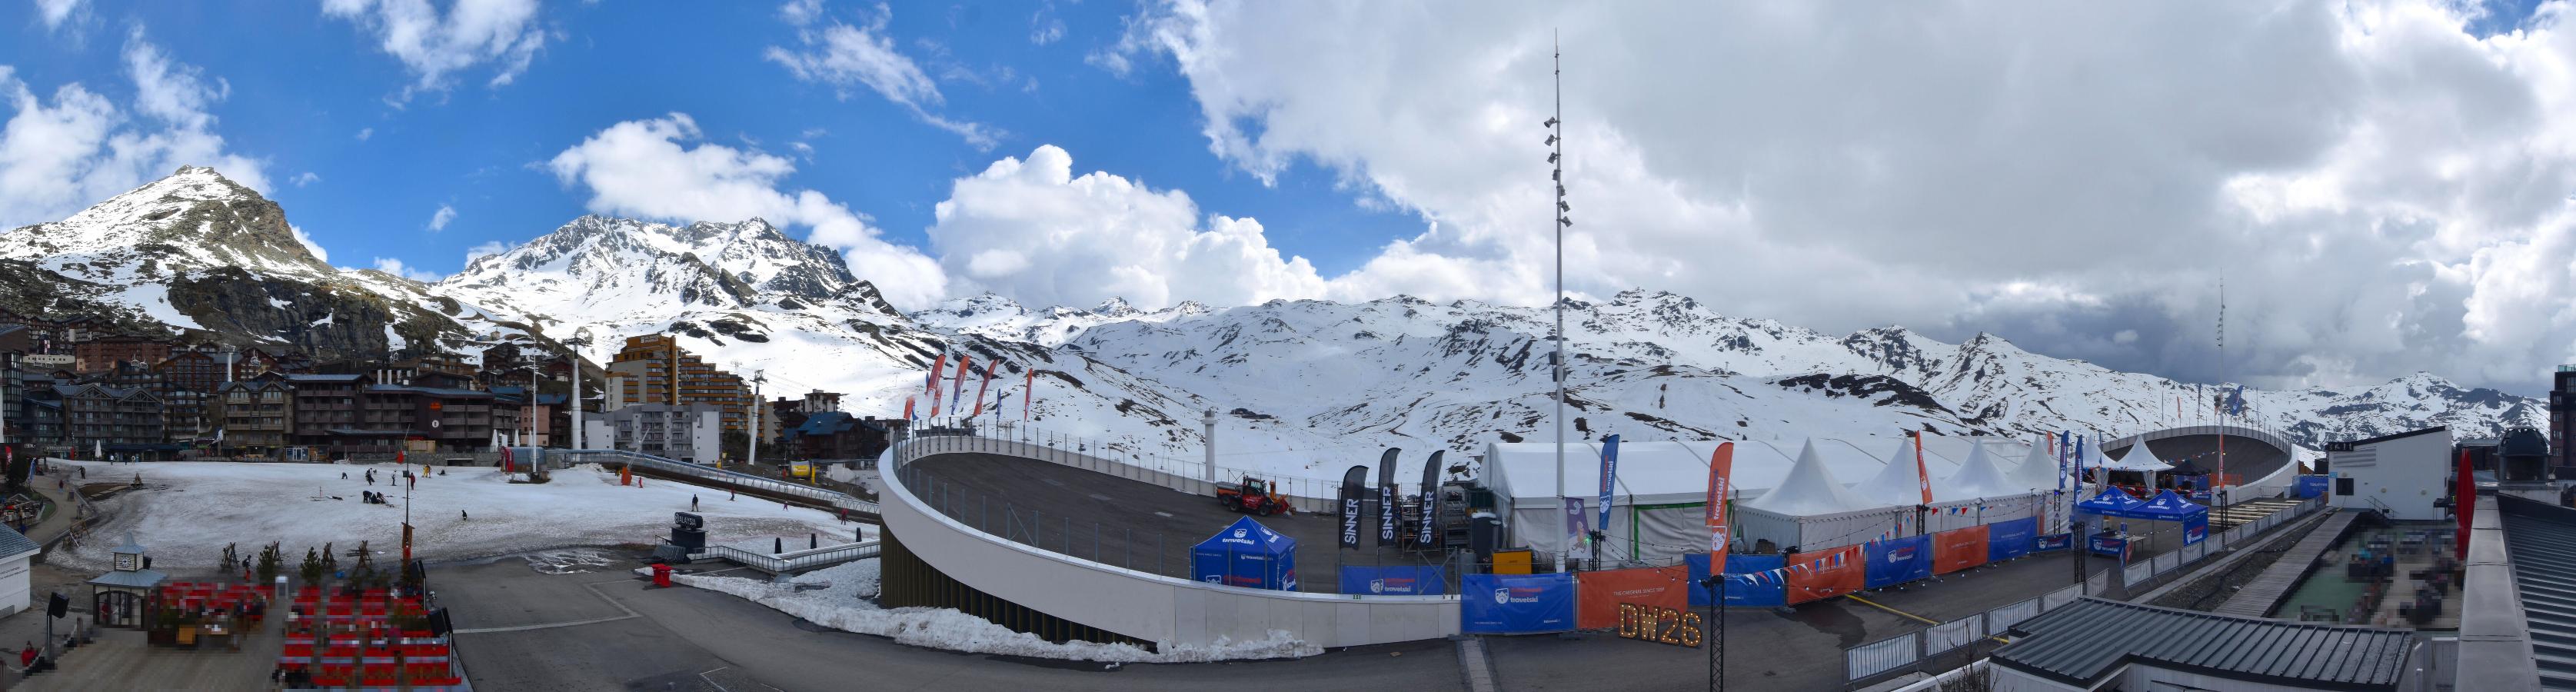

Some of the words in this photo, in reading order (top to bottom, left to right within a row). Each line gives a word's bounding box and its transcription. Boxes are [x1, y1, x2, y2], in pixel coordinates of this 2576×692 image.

[1345, 498, 1359, 544] SINNER
[1383, 486, 1393, 540] SINNER
[1420, 491, 1434, 544] SINNER
[1714, 477, 1725, 521] travelski
[1619, 602, 1702, 648] DW26
